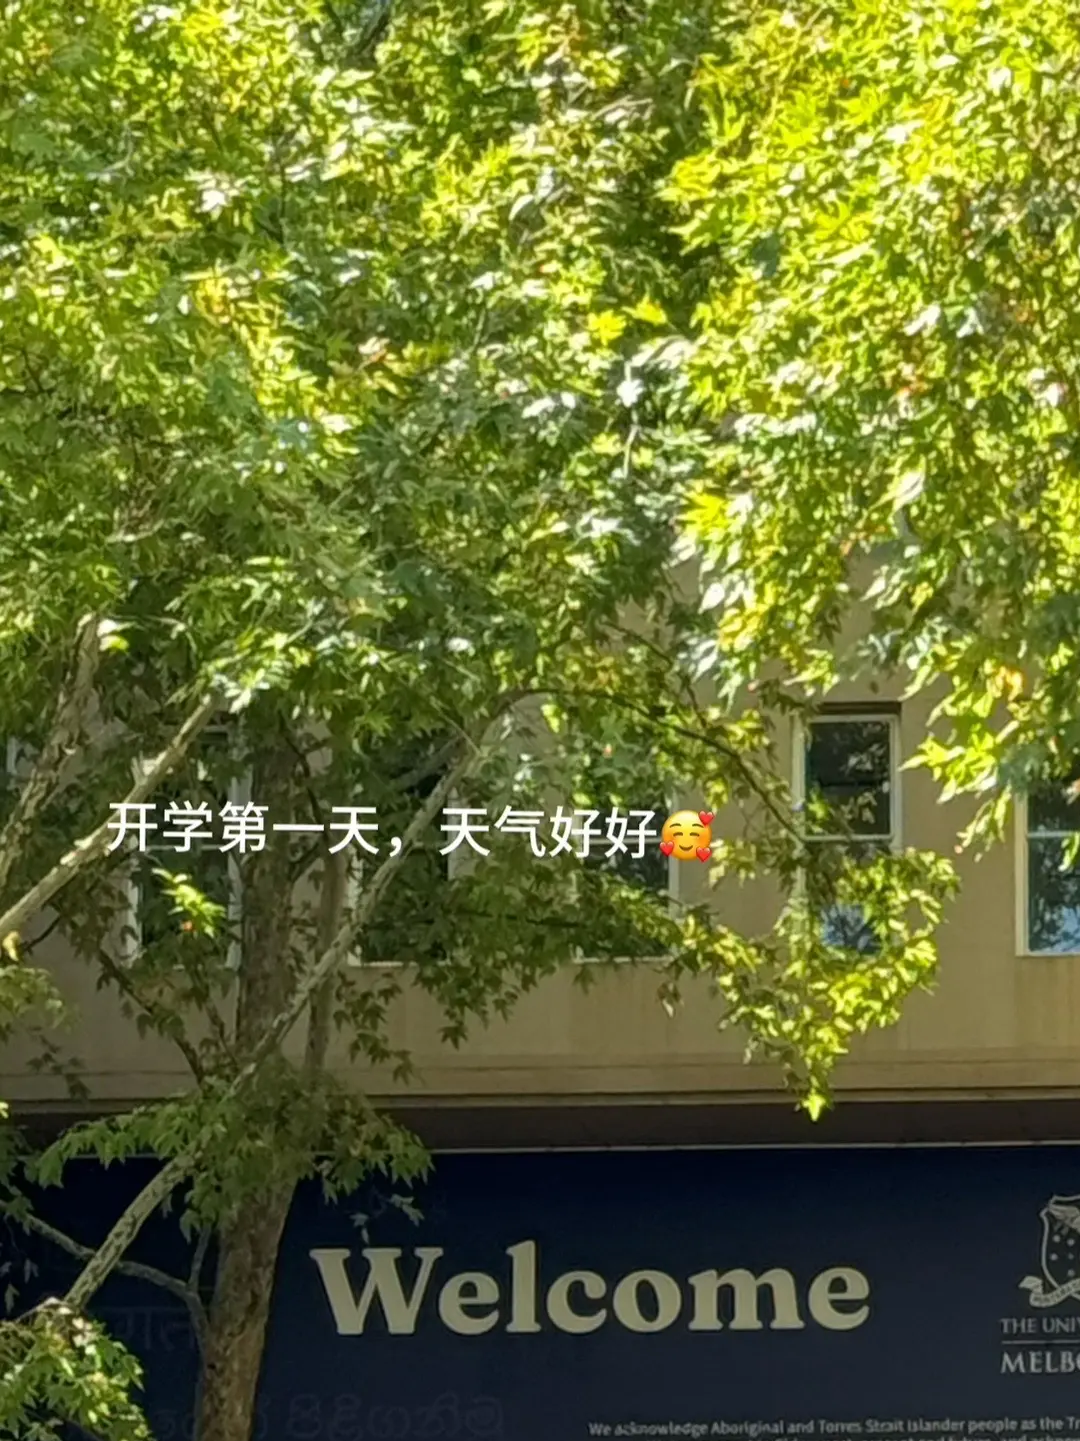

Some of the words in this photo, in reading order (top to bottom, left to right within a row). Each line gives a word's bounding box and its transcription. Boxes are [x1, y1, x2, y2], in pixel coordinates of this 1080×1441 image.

[309, 1240, 869, 1335] Welcome
[1001, 1317, 1037, 1333] THE
[589, 1421, 612, 1436] We
[614, 1420, 708, 1438] acknowledge
[711, 1419, 784, 1438] Aboriginal
[787, 1420, 815, 1434] and
[819, 1419, 863, 1433] Torres
[866, 1418, 904, 1432] Strait
[907, 1416, 965, 1432] Islander
[968, 1416, 1017, 1434] people
[1021, 1419, 1037, 1430] as
[1039, 1416, 1063, 1430] the
